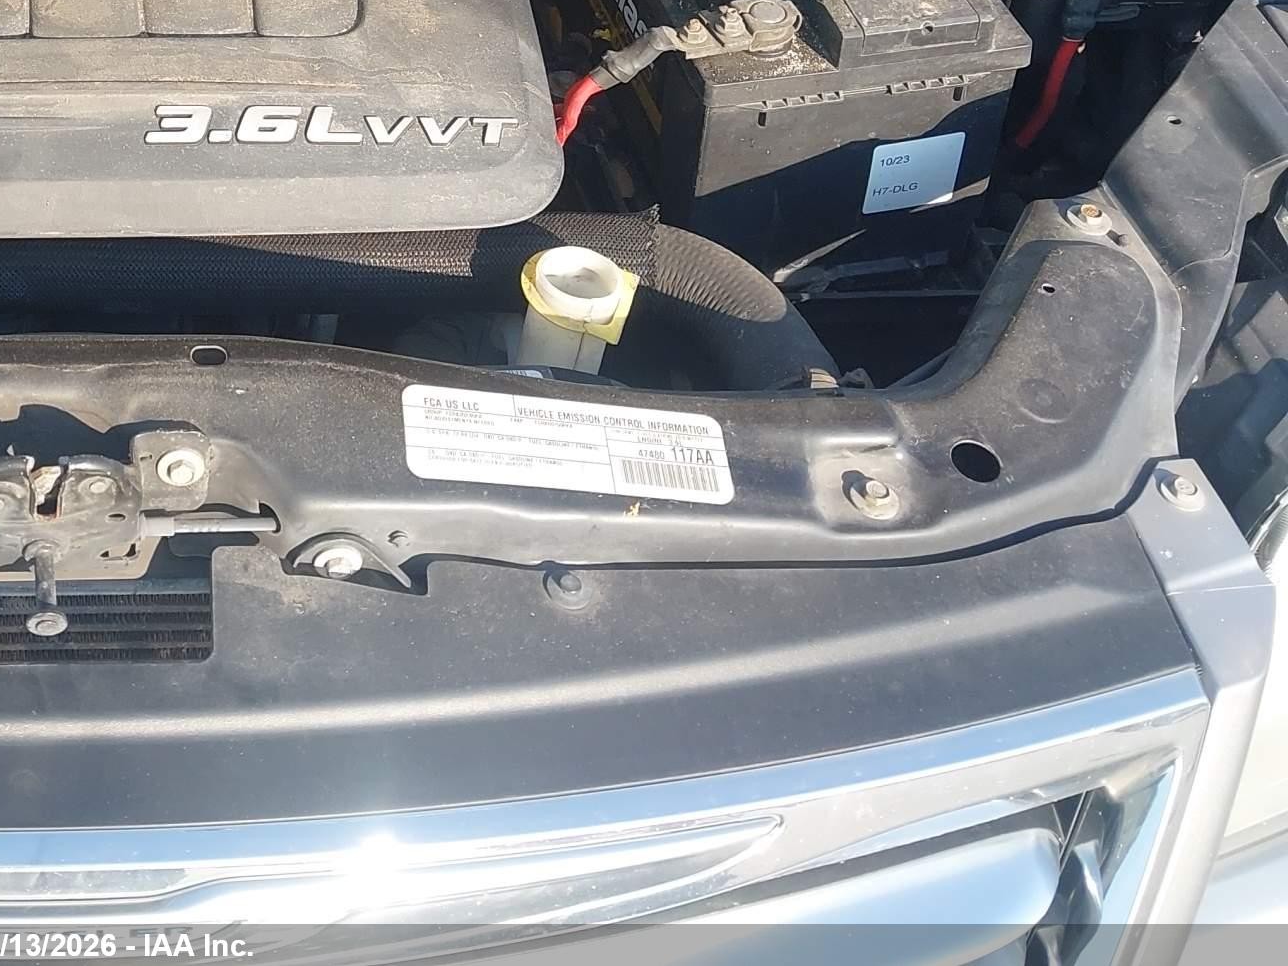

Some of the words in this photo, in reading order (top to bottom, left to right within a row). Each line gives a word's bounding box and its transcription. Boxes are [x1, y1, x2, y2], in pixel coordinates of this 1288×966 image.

[880, 155, 910, 167] 10/23
[873, 182, 918, 196] H7-DLG
[423, 397, 442, 408] FCA
[445, 399, 460, 409] US
[461, 400, 480, 411] LLC
[517, 407, 555, 420] VEHICLE
[557, 410, 601, 424] EMISSION
[603, 415, 645, 429] CONTROL
[647, 420, 710, 435] INFORMATION
[671, 447, 714, 464] 117AA
